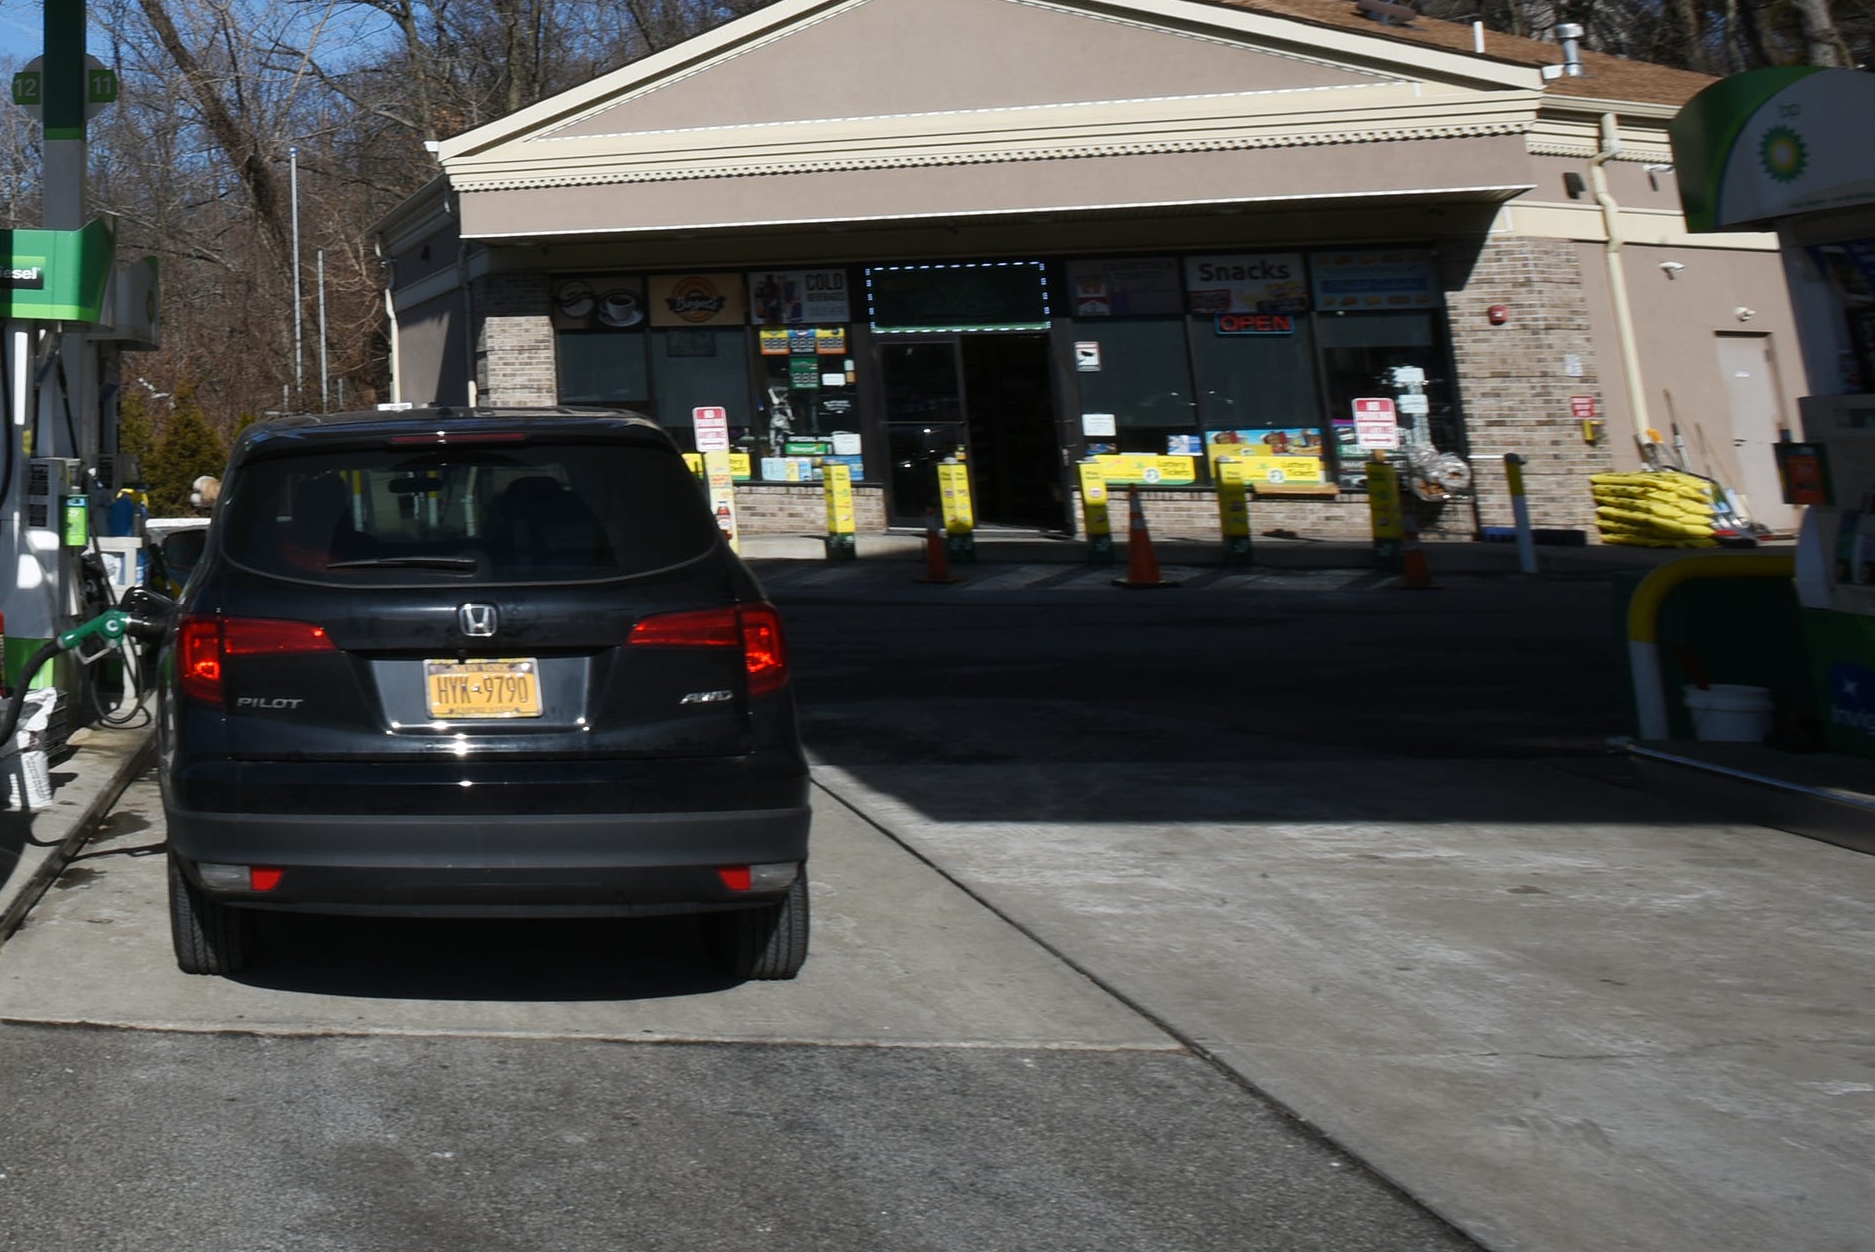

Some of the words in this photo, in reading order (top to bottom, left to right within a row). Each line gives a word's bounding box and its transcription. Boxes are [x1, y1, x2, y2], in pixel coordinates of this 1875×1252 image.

[15, 78, 37, 97] 12
[92, 76, 112, 94] 11
[1198, 260, 1290, 281] Snacks
[806, 273, 843, 290] COLD
[1220, 315, 1291, 332] OPEN
[237, 697, 304, 709] PILOT
[679, 690, 733, 704] AWD
